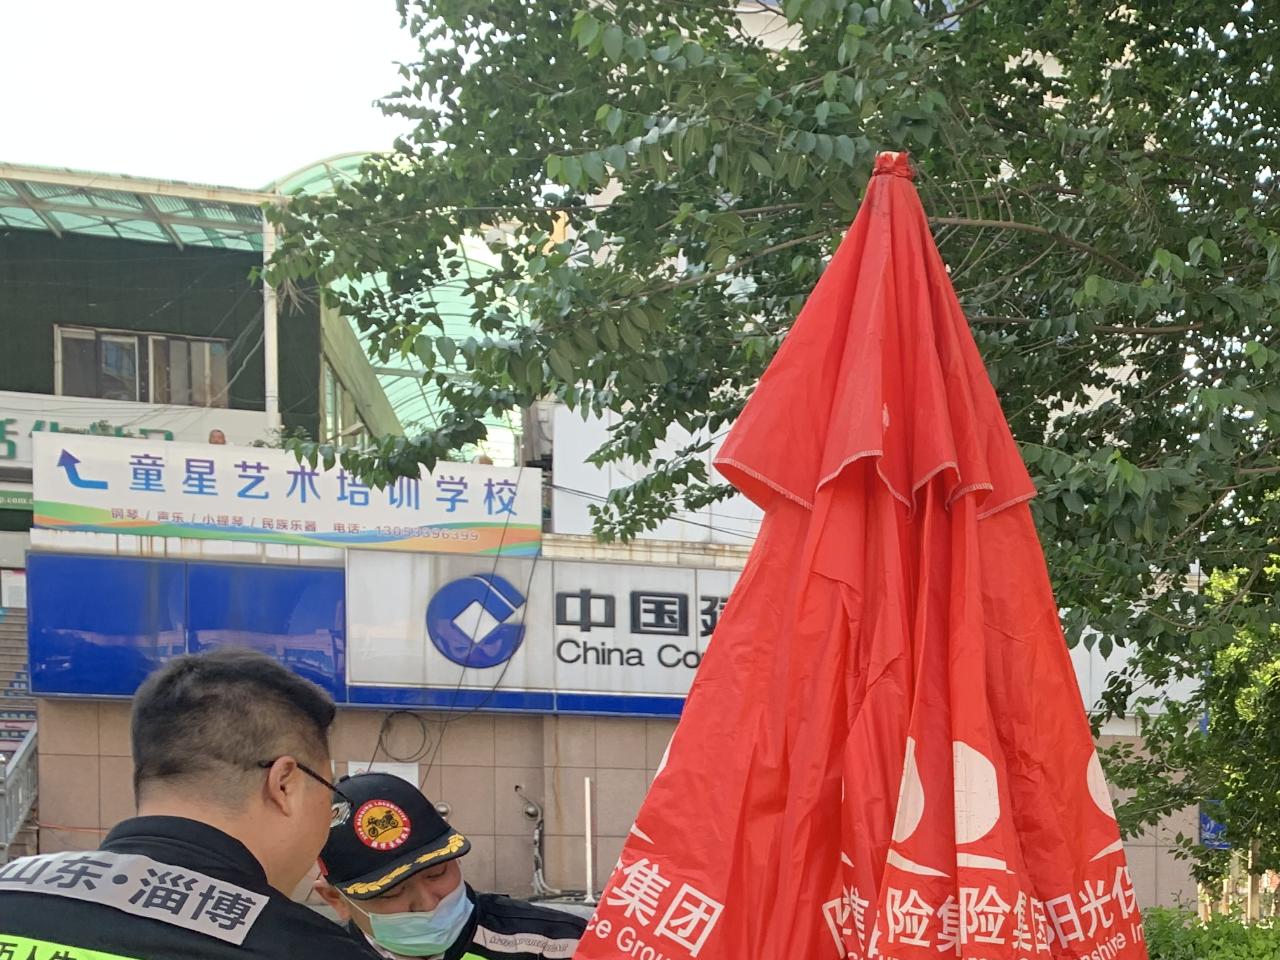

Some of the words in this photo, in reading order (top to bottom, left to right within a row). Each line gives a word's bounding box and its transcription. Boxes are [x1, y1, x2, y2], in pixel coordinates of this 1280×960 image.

[129, 453, 518, 516] 童星艺术培训学校
[556, 638, 645, 667] China
[657, 643, 705, 669] Co
[606, 857, 725, 959] 集团
